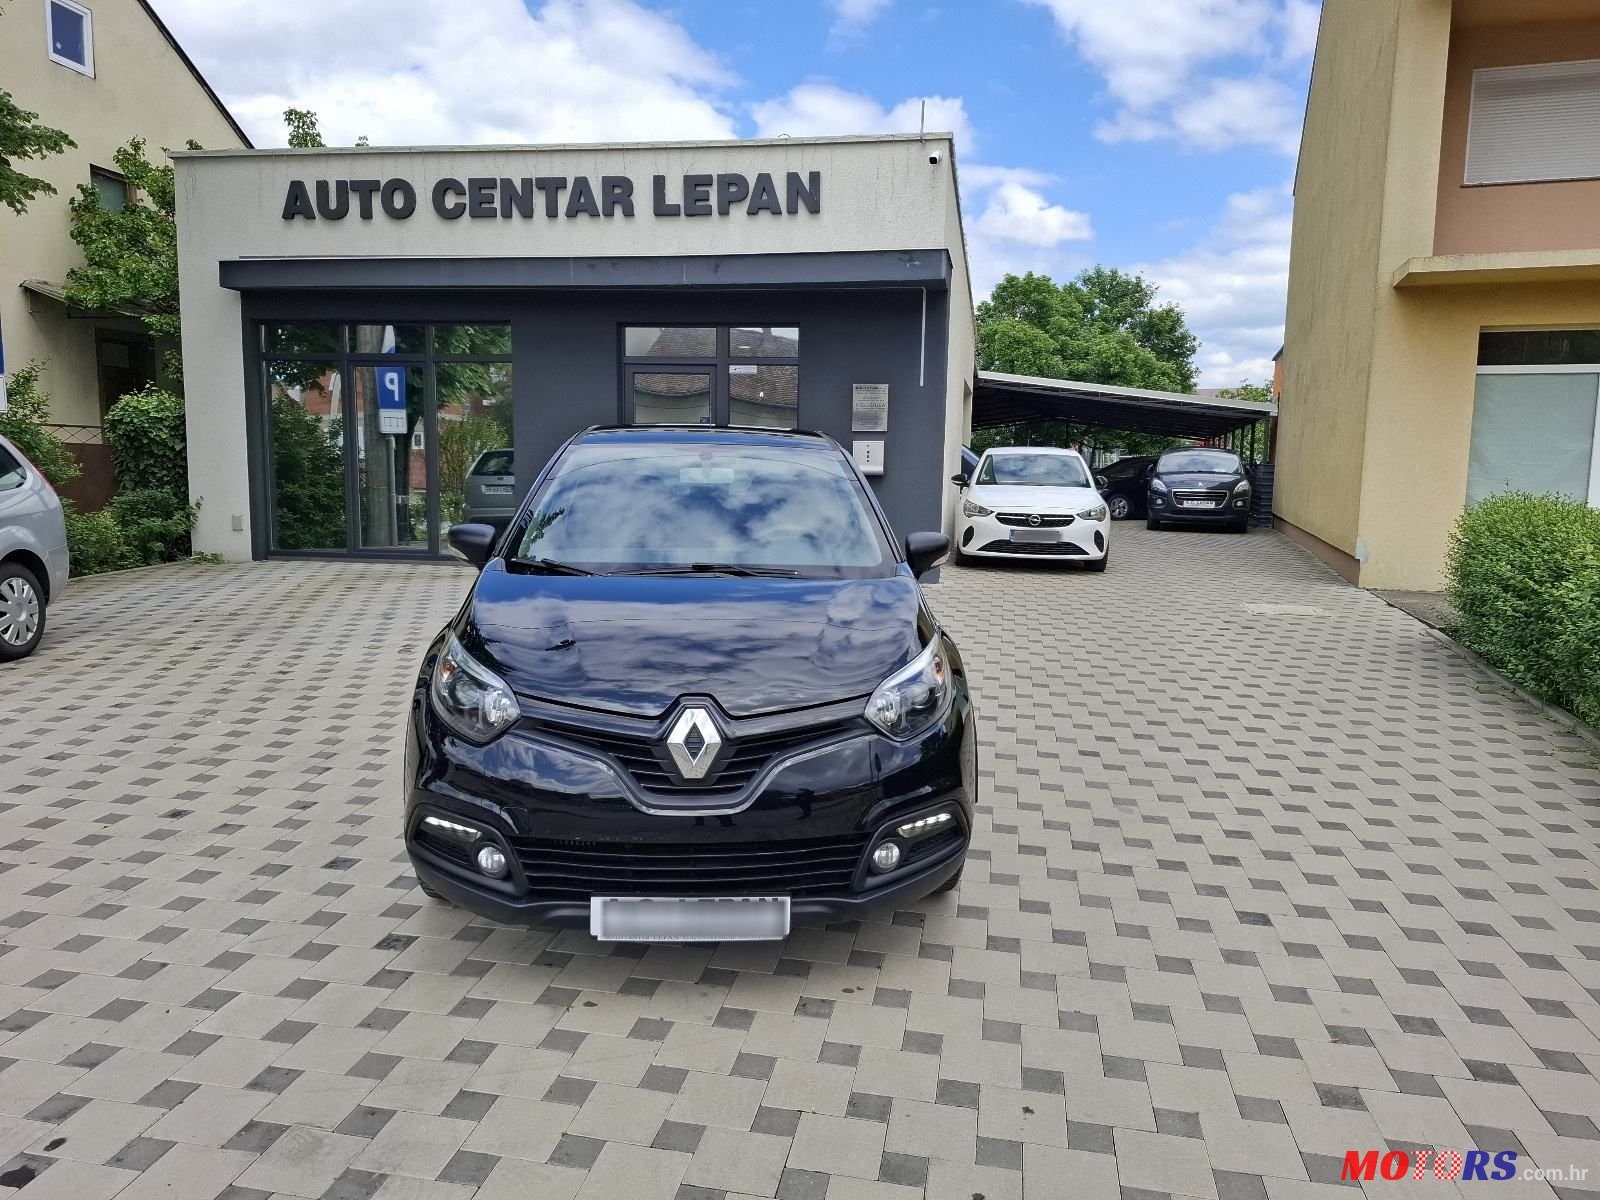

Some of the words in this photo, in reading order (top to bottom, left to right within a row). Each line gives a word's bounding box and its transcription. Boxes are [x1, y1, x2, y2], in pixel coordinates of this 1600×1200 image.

[282, 178, 416, 222] AUTO
[432, 177, 634, 220] CENTAR
[653, 171, 820, 217] LEPAN
